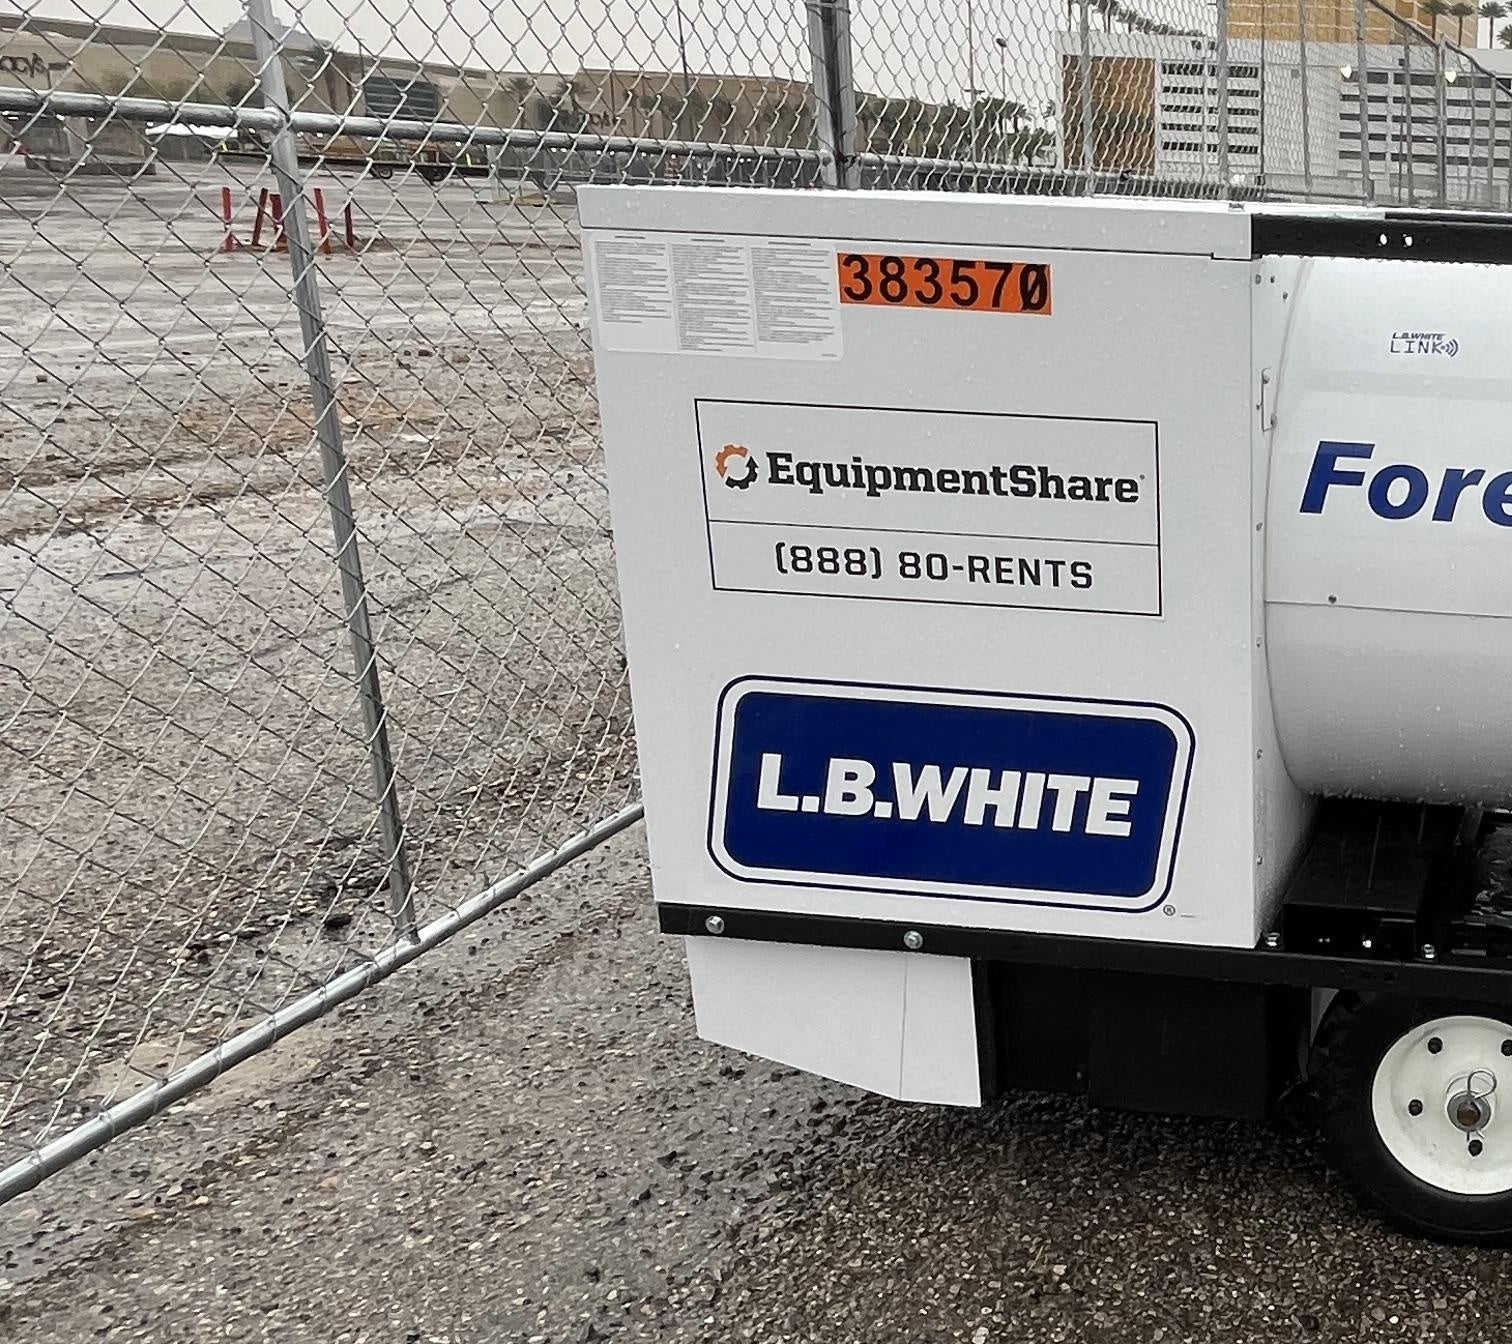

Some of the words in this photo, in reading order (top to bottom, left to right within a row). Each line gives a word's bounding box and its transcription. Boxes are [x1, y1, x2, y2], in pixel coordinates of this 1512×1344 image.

[841, 253, 1048, 312] 383570
[1390, 340, 1442, 354] LINK
[766, 451, 1139, 504] EquipmentShare
[775, 542, 881, 579] (888)
[899, 552, 1093, 590] 80-RENTS
[757, 752, 1140, 837] L.B.WHITE
